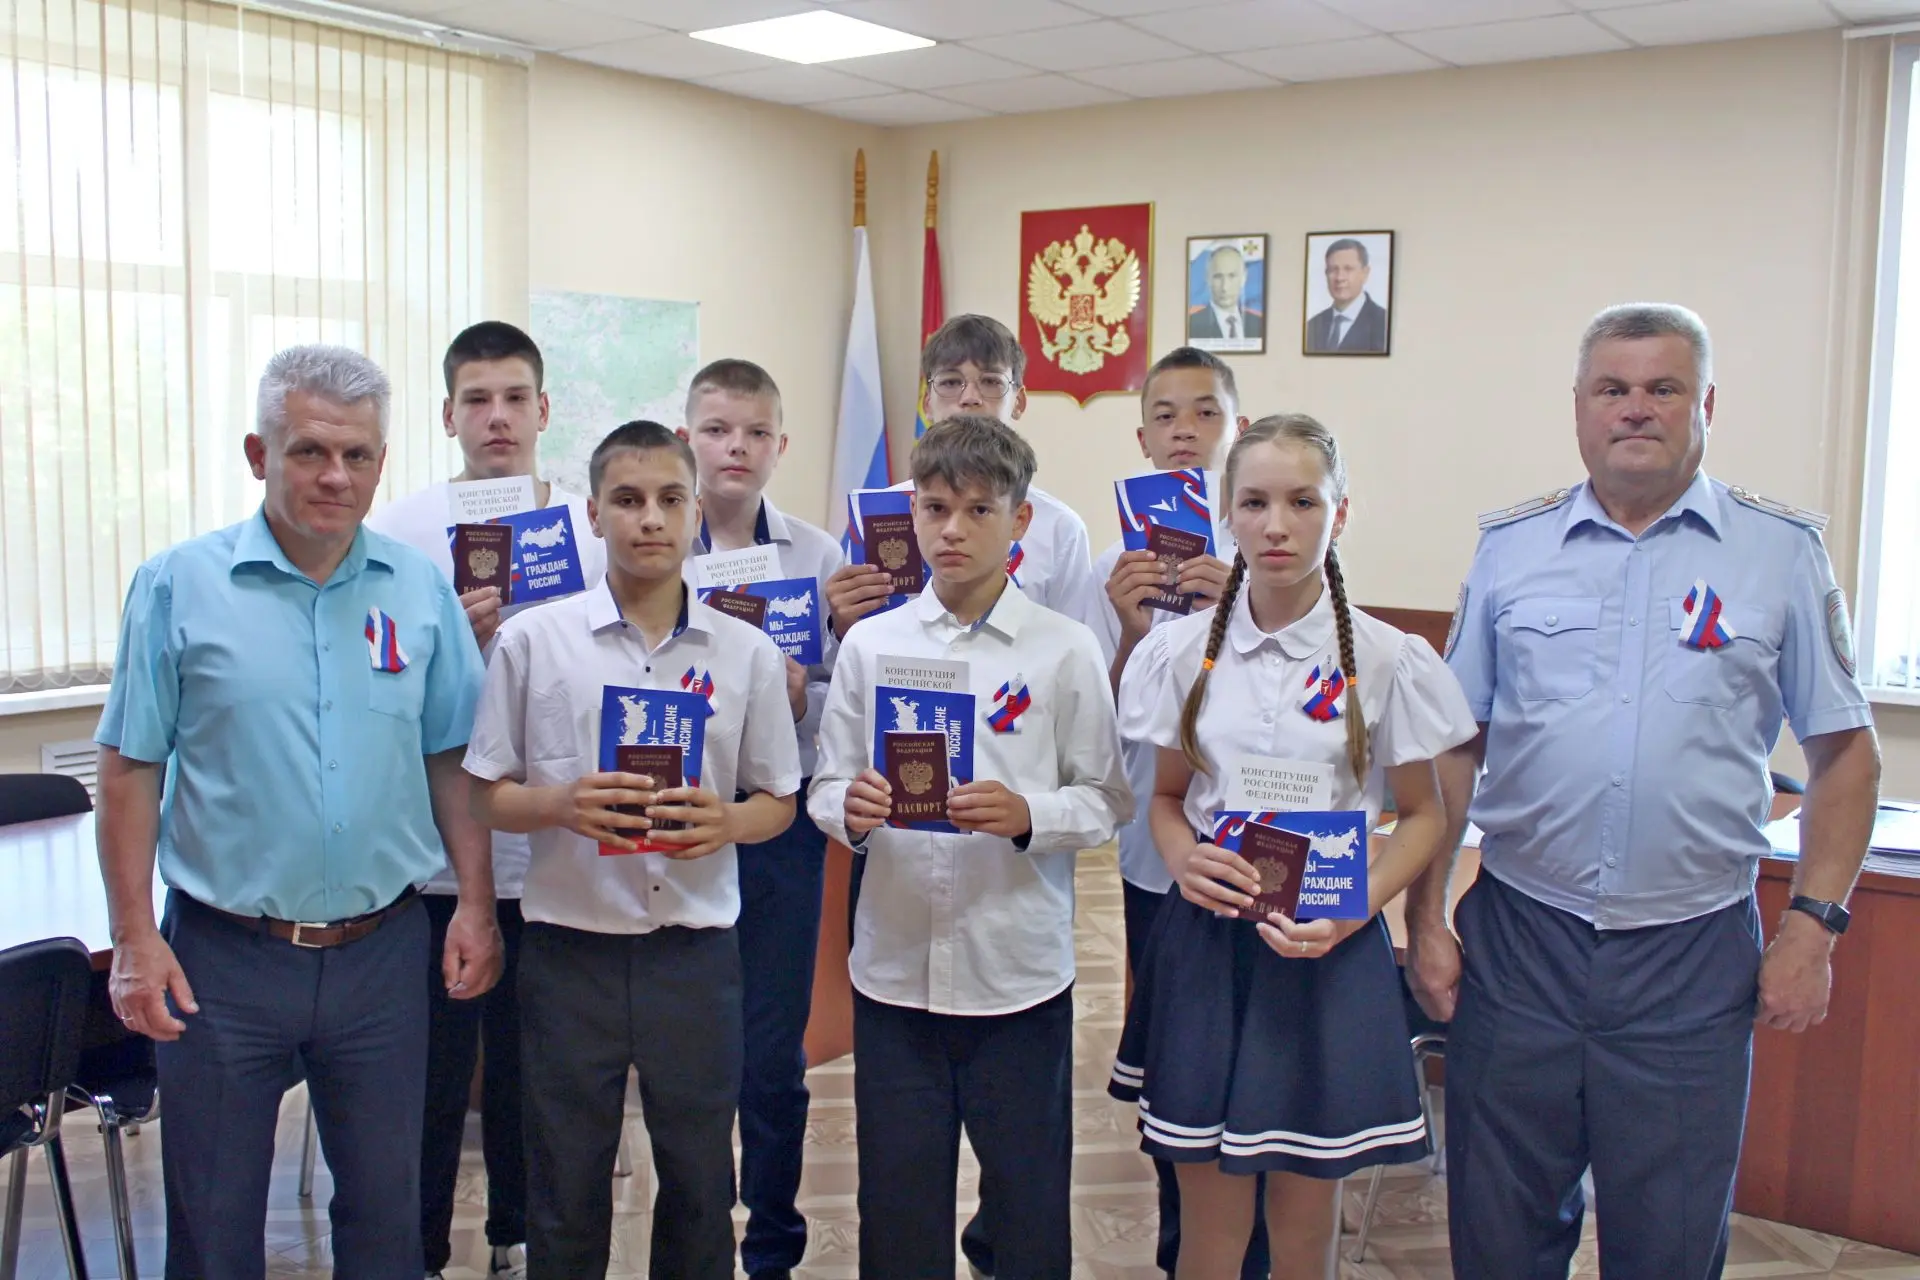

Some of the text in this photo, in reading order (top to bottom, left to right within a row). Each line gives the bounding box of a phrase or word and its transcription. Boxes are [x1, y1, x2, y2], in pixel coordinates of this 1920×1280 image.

[458, 486, 522, 499] КОНСТИТУЦИЯ
[462, 494, 520, 507] РОССИЙСКОЙ
[466, 505, 518, 516] ФЕДЕРАЦИИ
[522, 552, 538, 563] МЫ
[706, 555, 768, 571] КОНСТИТУЦИЯ
[525, 558, 569, 576] ГРАЖДАНЕ
[711, 563, 767, 580] РОССИЙСКОЙ
[528, 574, 562, 590] РОССИИ!
[769, 620, 783, 631] МЫ
[885, 666, 956, 680] КОНСТИТУЦИЯ
[888, 677, 952, 690] РОССИЙСКОЙ
[663, 704, 678, 744] АЖДАНЕ
[949, 720, 961, 757] РОССИИ!
[1241, 766, 1319, 784] КОНСТИТУЦИЯ
[1243, 777, 1314, 794] РОССИЙСКОЙ
[1245, 789, 1309, 804] ФЕДЕРАЦИИ
[897, 802, 941, 814] ПАСПОРТ
[1305, 860, 1316, 872] Ы
[1304, 877, 1354, 890] РАЖДАНЕ
[1299, 893, 1340, 905] РОССИИ!
